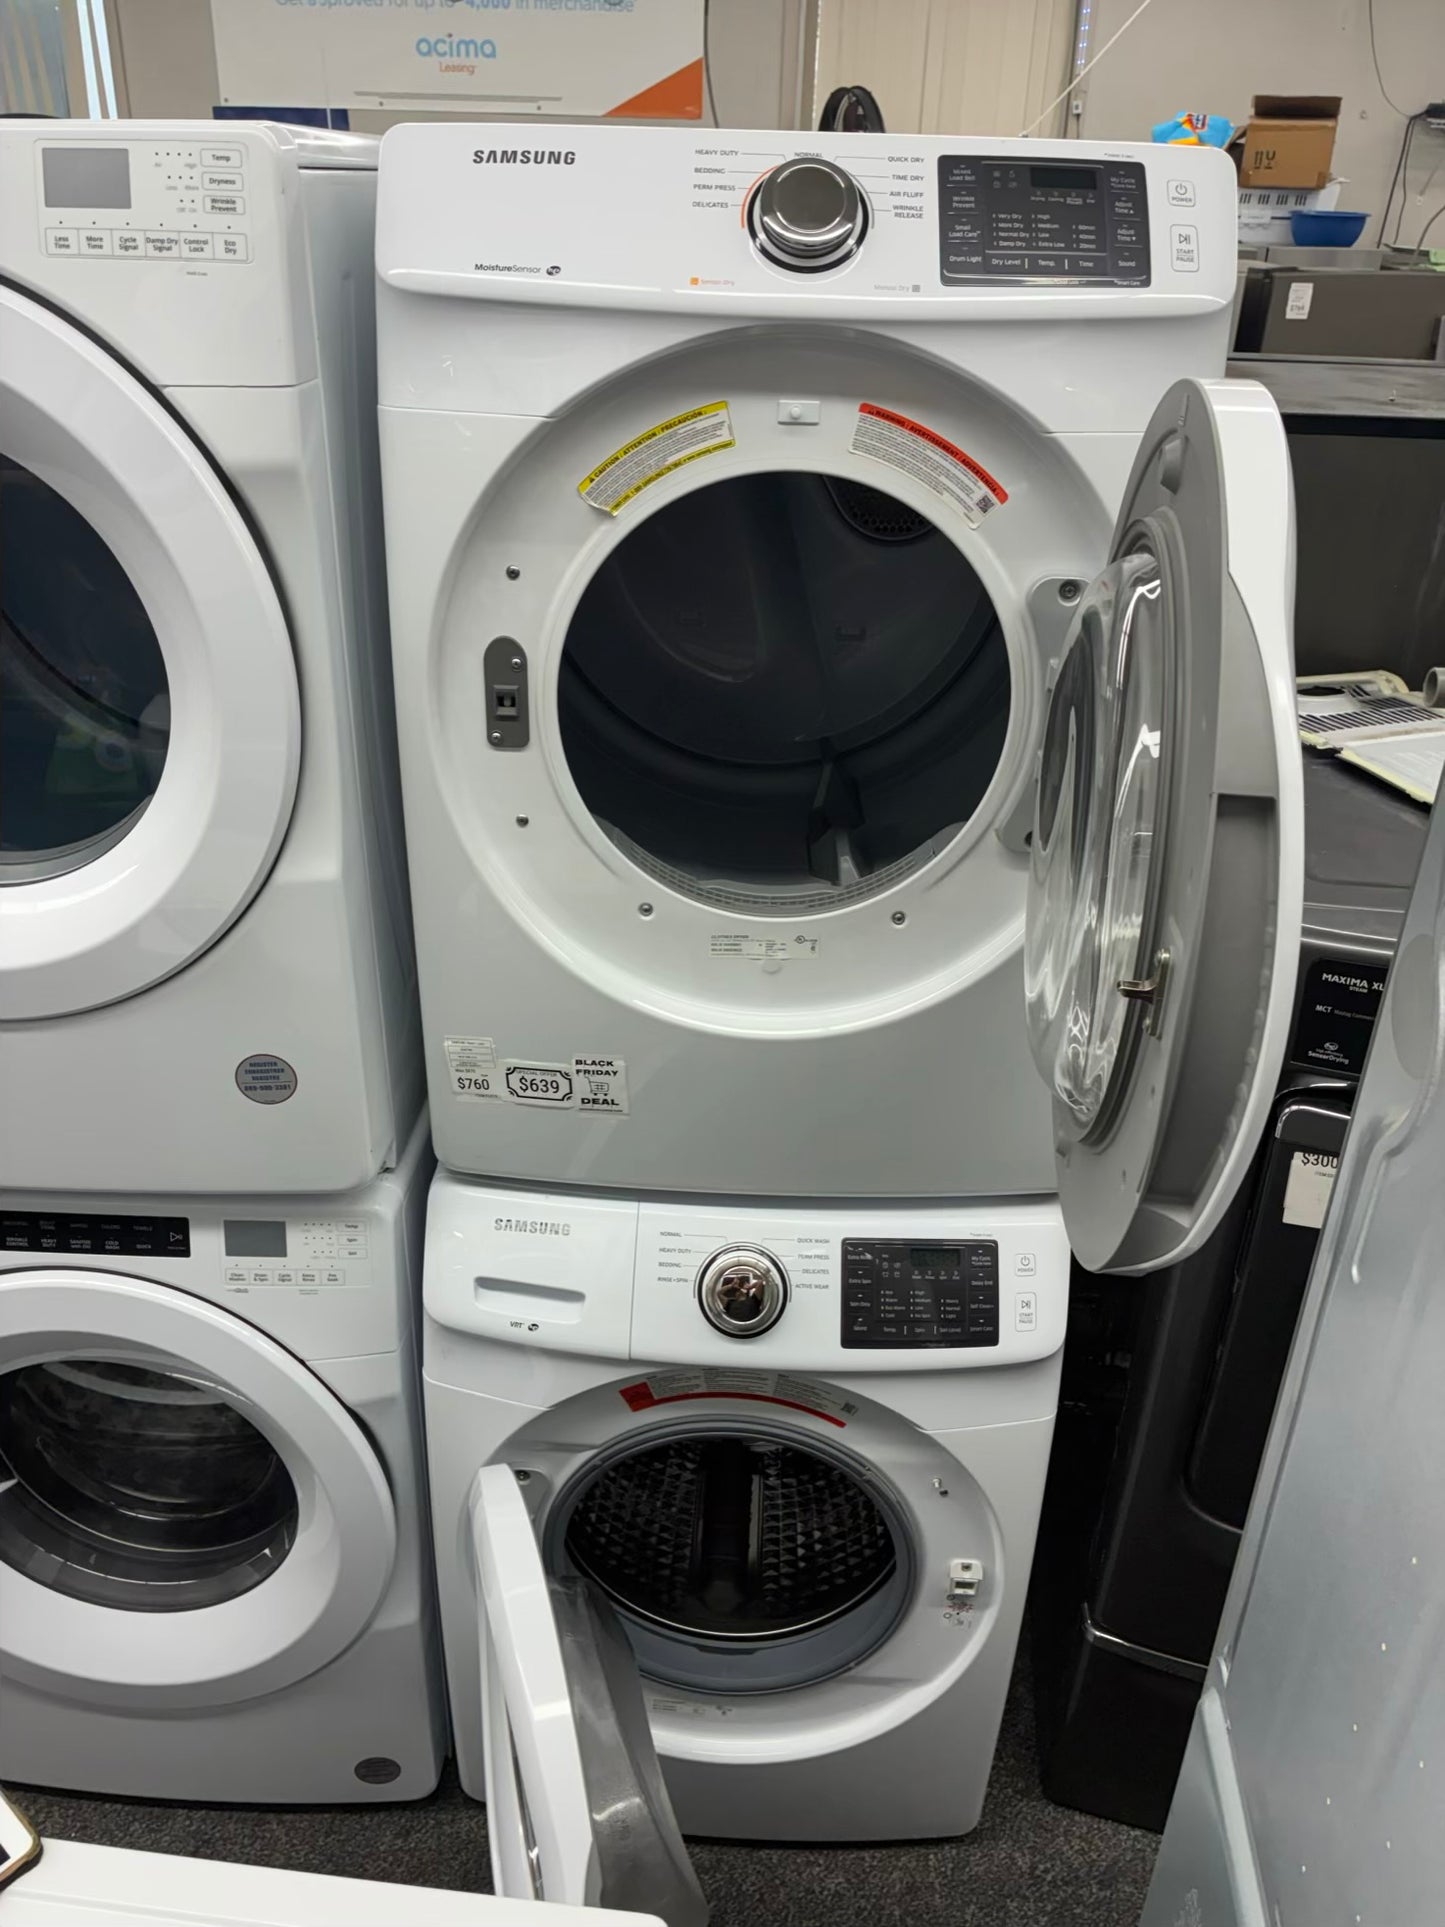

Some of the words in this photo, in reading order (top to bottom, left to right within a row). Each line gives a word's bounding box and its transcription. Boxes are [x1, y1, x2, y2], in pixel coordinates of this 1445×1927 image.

[415, 35, 496, 60] acima
[438, 62, 477, 75] Leasing
[211, 154, 231, 162] Temp
[472, 150, 576, 165] SAMSUNG
[208, 177, 236, 186] Dryness
[210, 204, 237, 212] Prevent
[892, 204, 924, 212] WRINKLE
[894, 211, 924, 219] RELEASE
[54, 235, 69, 243] Less
[86, 235, 104, 243] More
[119, 236, 137, 244] Cycle
[145, 237, 165, 246] Damp
[166, 237, 178, 246] Dry
[183, 238, 209, 246] Control
[54, 242, 71, 250] Time
[87, 242, 104, 250] Time
[119, 243, 139, 251] Signal
[152, 244, 173, 252] Signal
[188, 245, 204, 253] Lock
[225, 246, 237, 255] Dry
[474, 263, 541, 274] MoistureSensor
[594, 455, 621, 478] CAUTION
[623, 431, 658, 456] ATTENTION
[1321, 972, 1369, 988] MAXIMA
[1372, 981, 1385, 991] XL
[1315, 1004, 1333, 1013] MCT
[575, 1059, 615, 1067] BLACK
[457, 1076, 490, 1091] $760
[519, 1076, 560, 1094] $639
[580, 1097, 620, 1106] DEAL
[1301, 1152, 1338, 1169] $300
[494, 1218, 572, 1236] SAMSUNG
